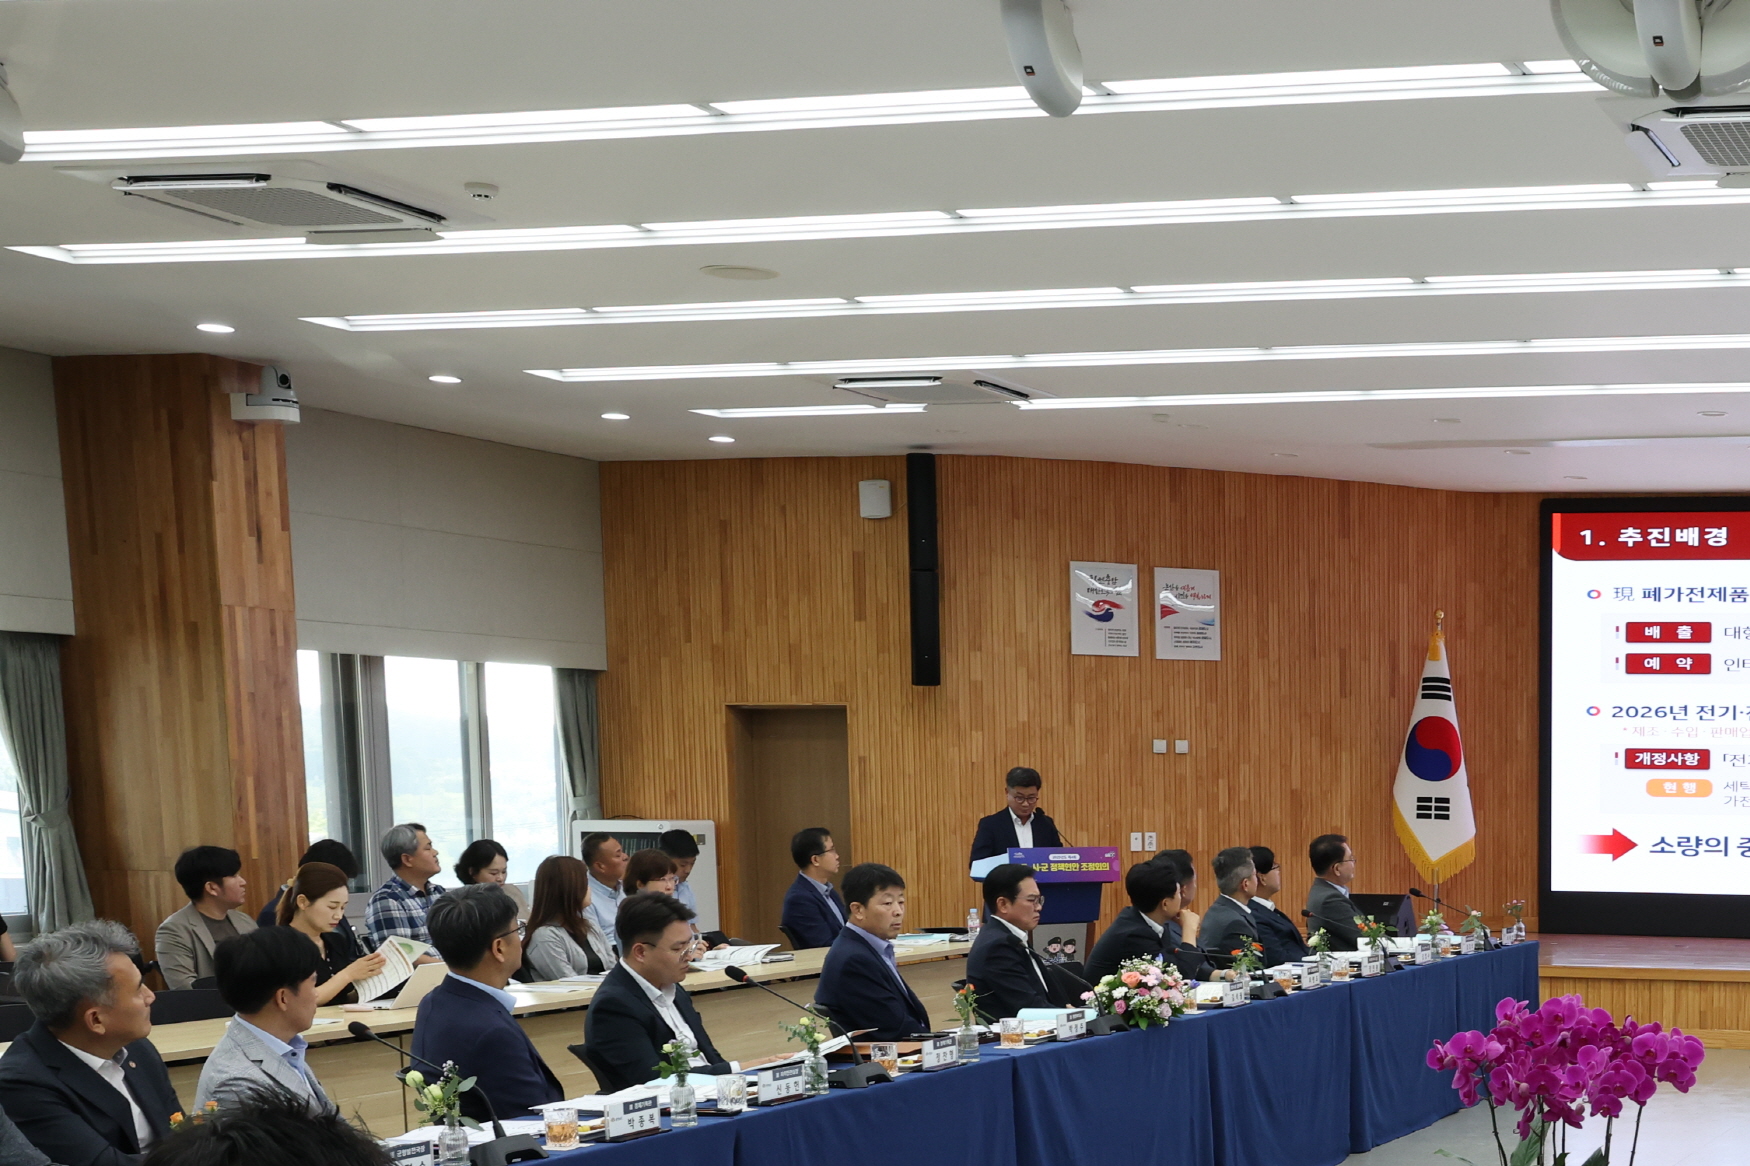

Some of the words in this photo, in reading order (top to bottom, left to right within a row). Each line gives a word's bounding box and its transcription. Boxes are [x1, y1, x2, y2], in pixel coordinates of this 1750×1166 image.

[1579, 529, 1606, 547] 1.
[1617, 526, 1728, 548] 추진배경
[1641, 586, 1750, 603] 폐가전제품
[1611, 704, 1688, 721] 2026년
[1634, 751, 1701, 766] 개정사항
[1649, 835, 1729, 858] 소량의
[1050, 863, 1079, 872] 정책현안
[1080, 863, 1110, 871] 조정회의
